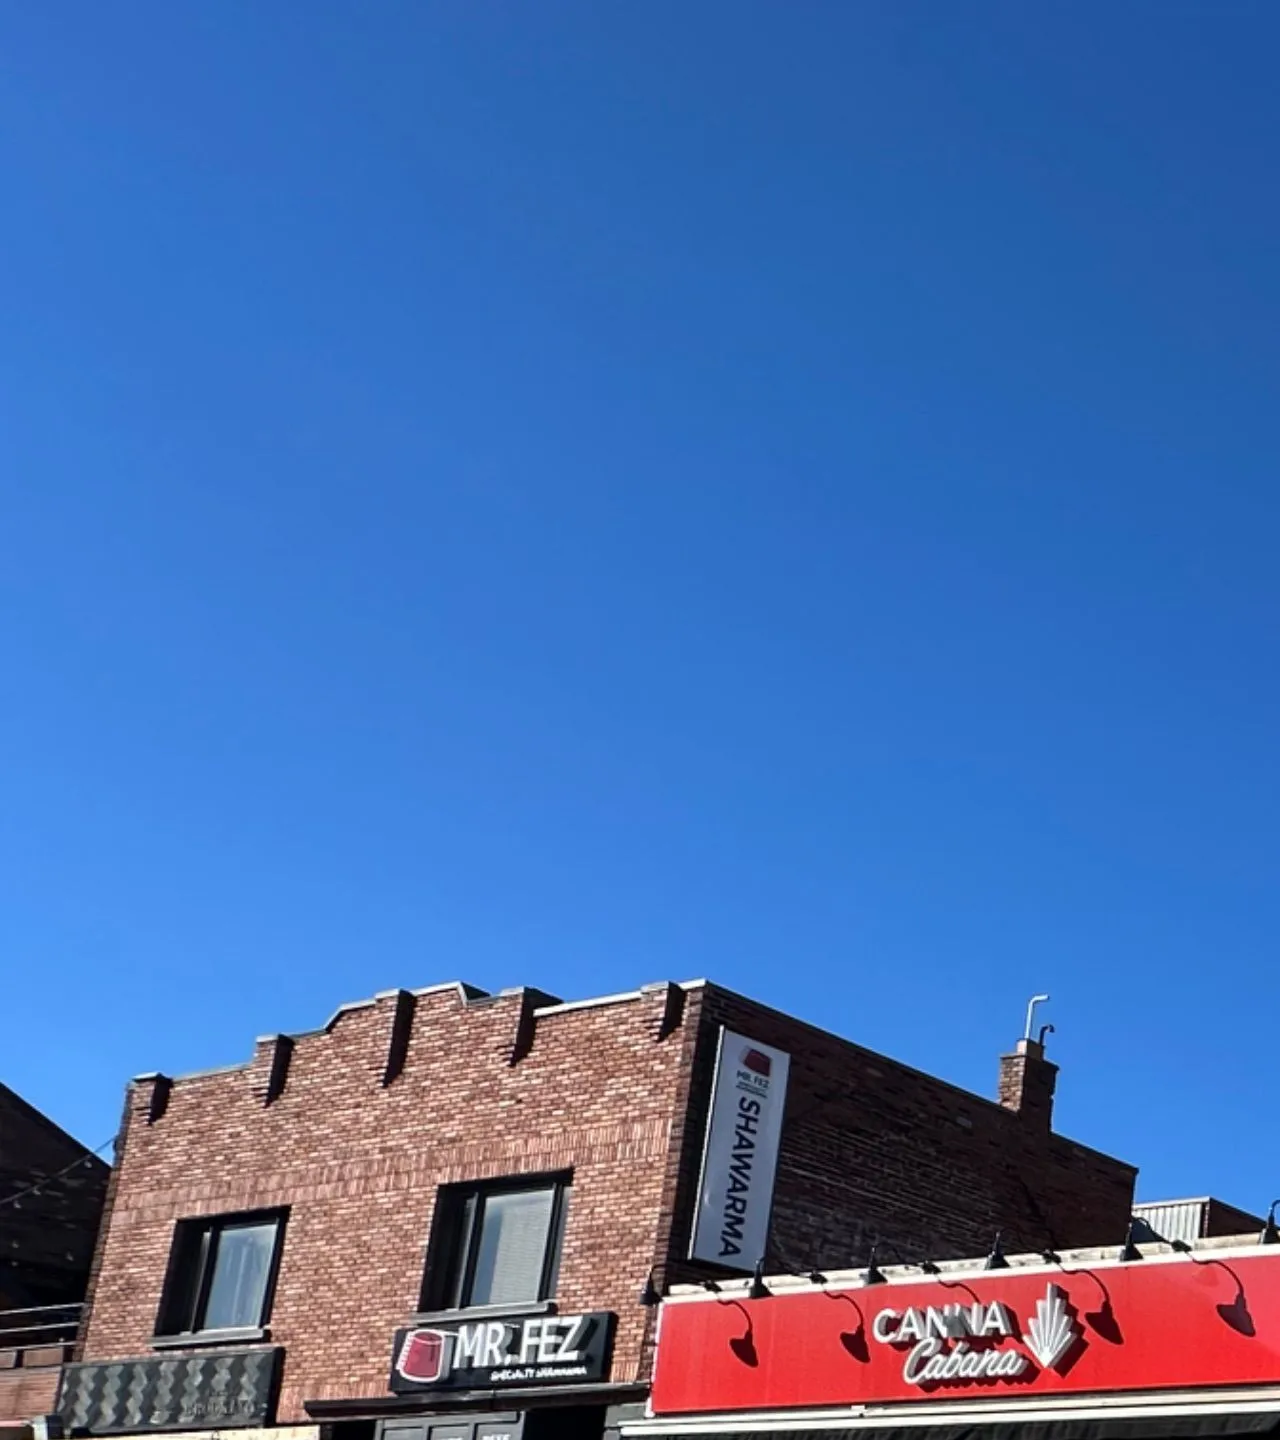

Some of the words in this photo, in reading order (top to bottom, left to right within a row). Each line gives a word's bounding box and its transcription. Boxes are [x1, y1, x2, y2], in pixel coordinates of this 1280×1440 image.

[718, 1096, 760, 1257] SHAWARMA
[519, 1315, 586, 1364] FEZ
[872, 1301, 1009, 1343] CANNA
[903, 1337, 1026, 1384] Cabana
